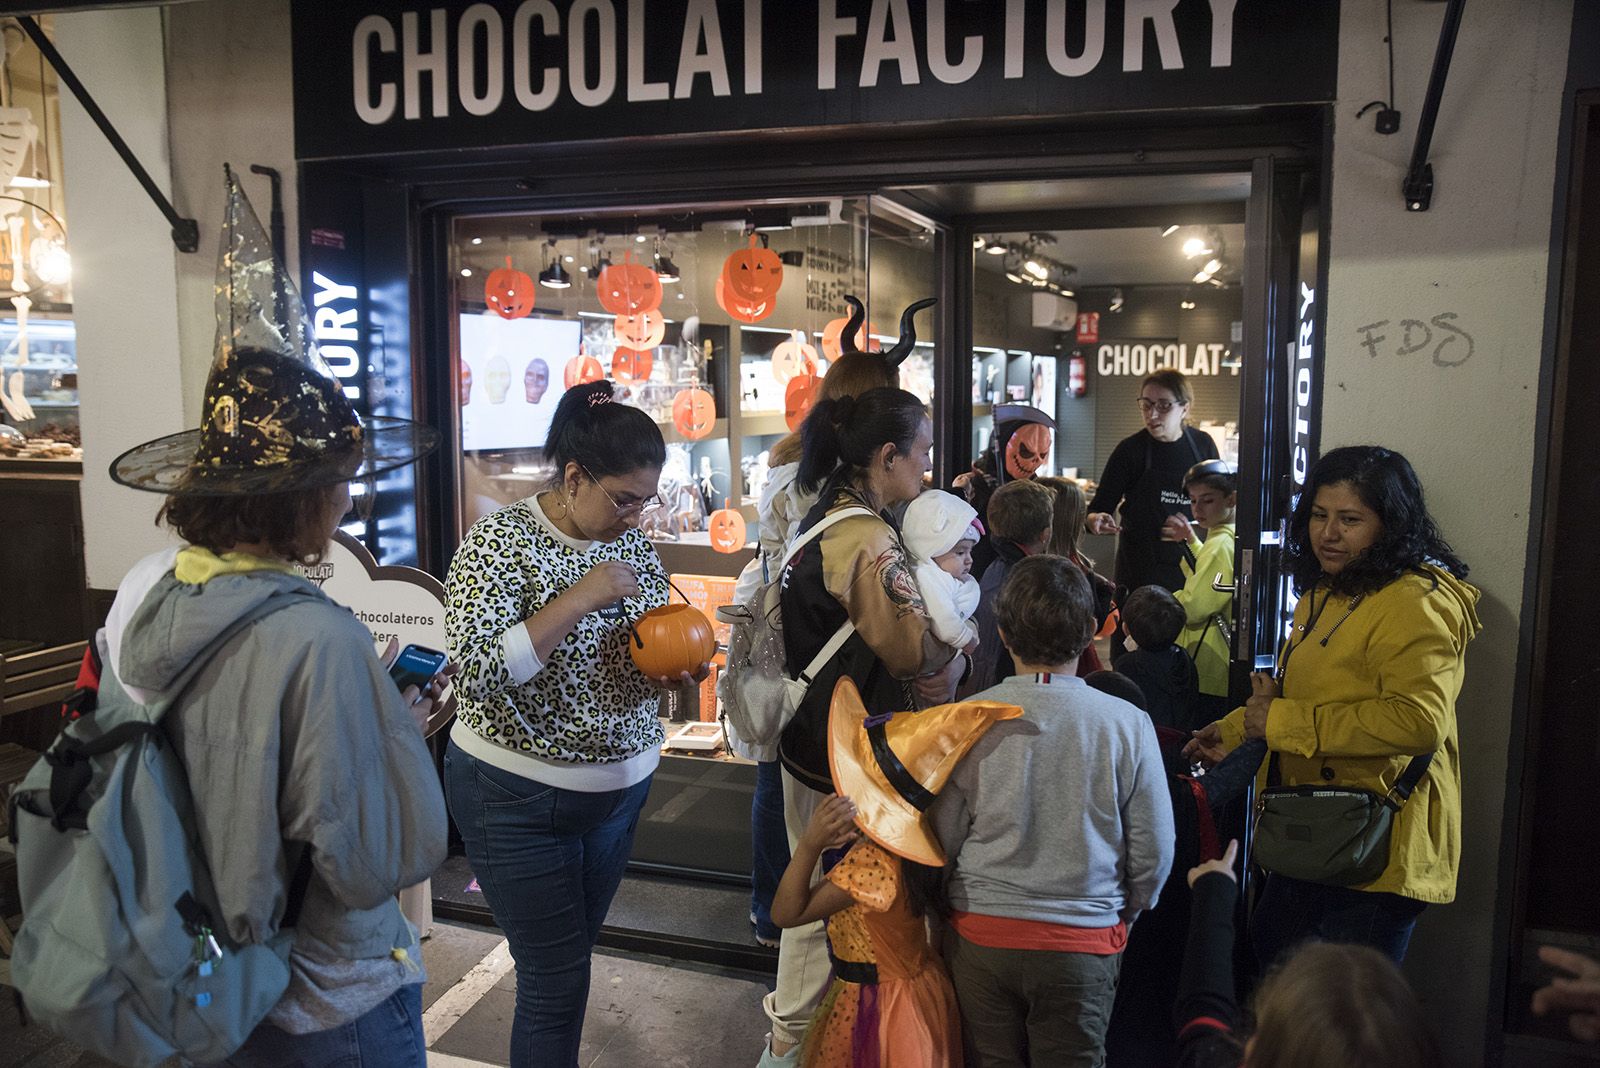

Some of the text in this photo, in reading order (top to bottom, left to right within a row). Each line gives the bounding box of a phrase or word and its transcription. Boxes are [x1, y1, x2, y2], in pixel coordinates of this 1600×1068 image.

[352, 0, 1239, 125] CHOCOLAT FACTORY
[1097, 343, 1224, 376] CHOCOLAT
[354, 610, 435, 626] chocolateros
[370, 631, 398, 643] ters
